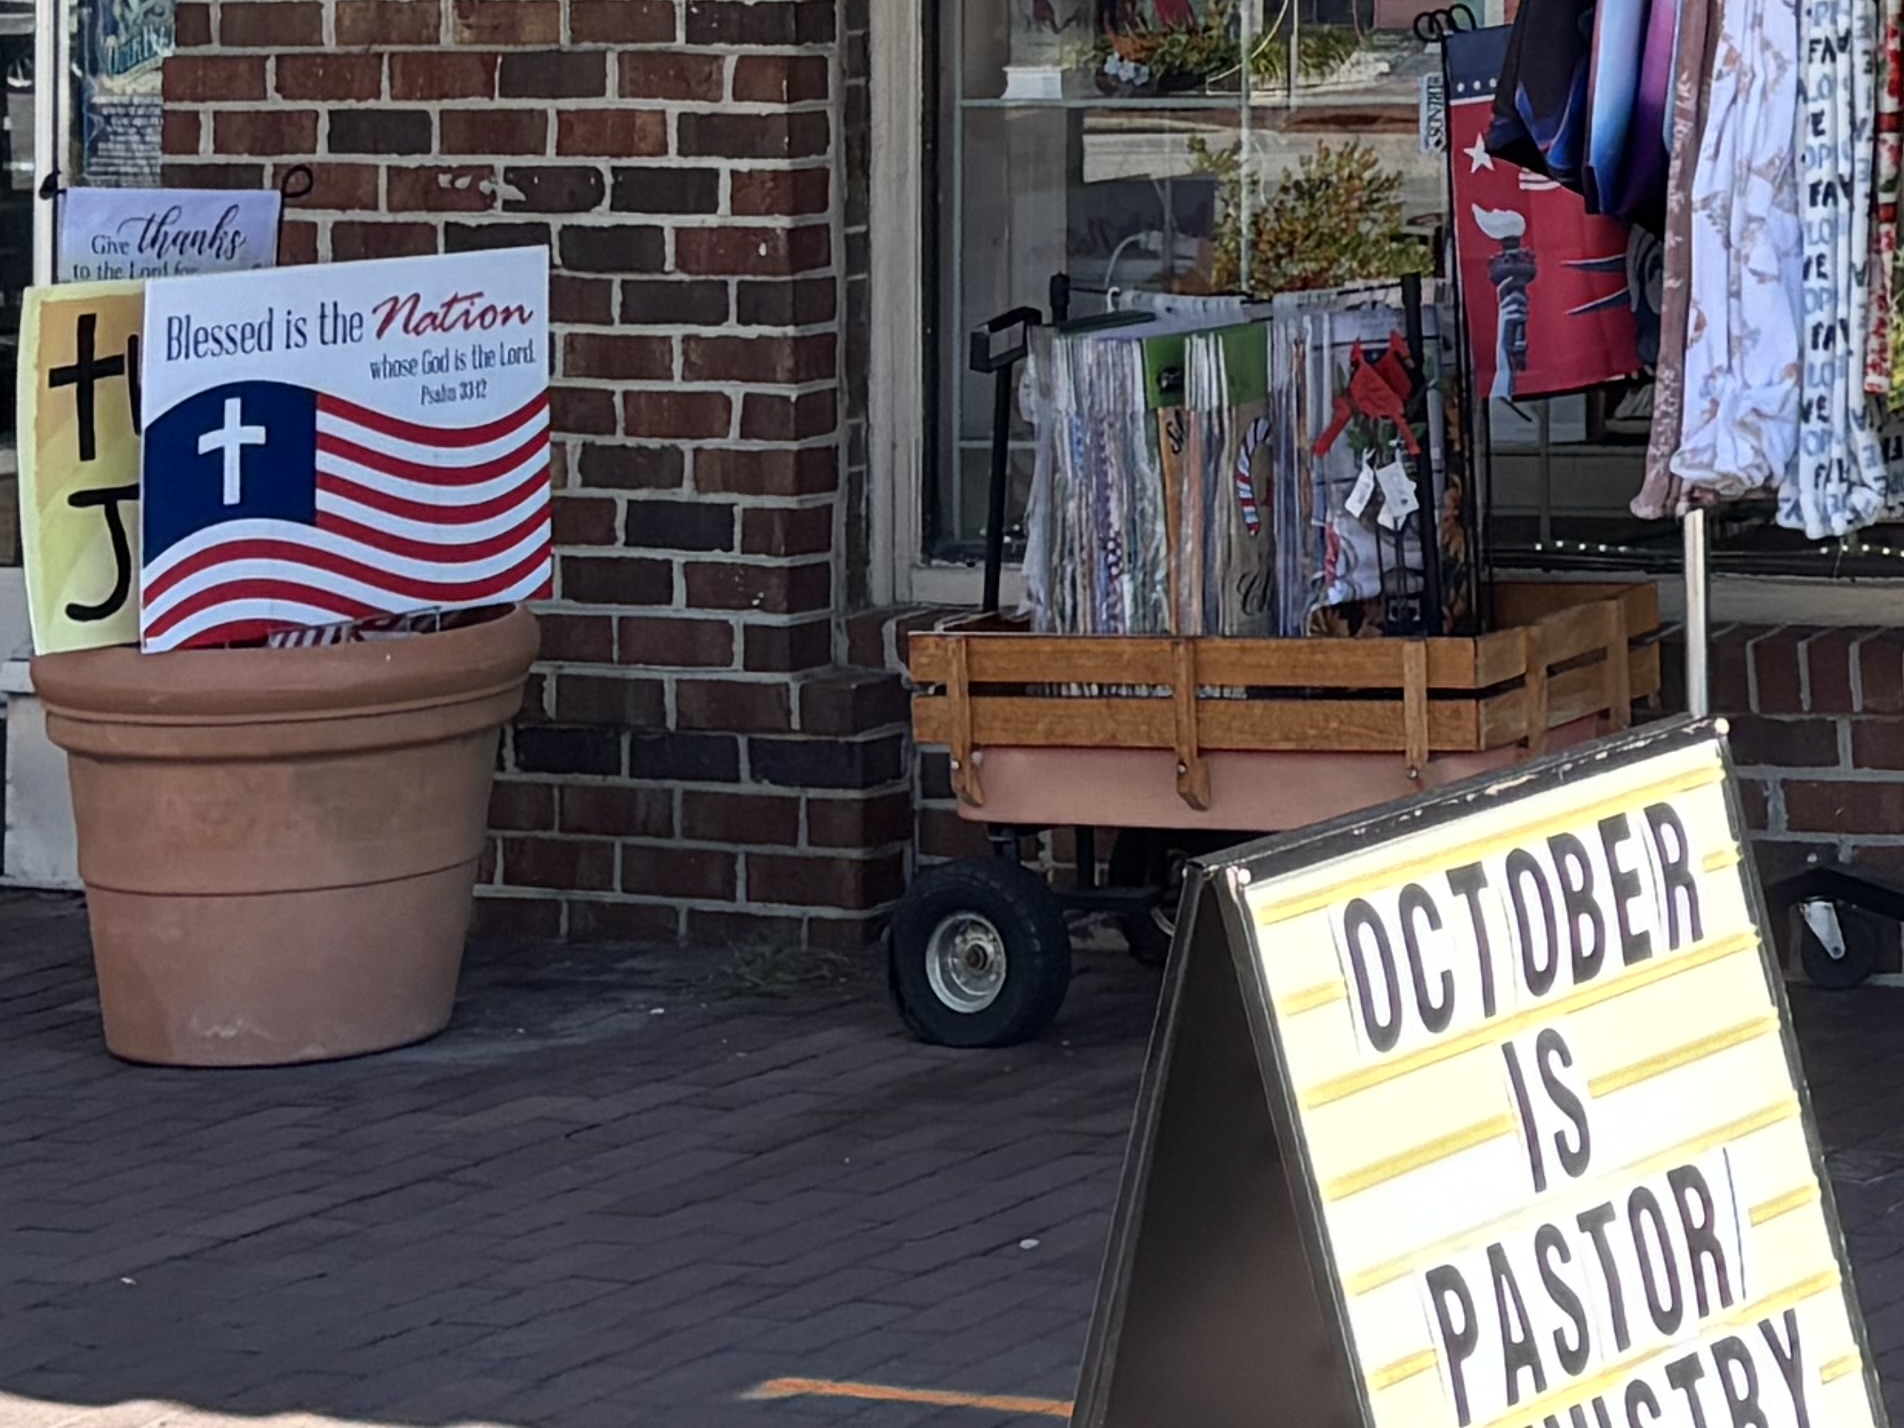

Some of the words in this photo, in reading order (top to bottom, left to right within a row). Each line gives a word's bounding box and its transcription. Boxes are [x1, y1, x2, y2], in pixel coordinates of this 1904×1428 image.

[91, 234, 130, 255] Give
[116, 203, 246, 261] thanks
[73, 263, 91, 281] to
[97, 260, 124, 281] the
[166, 306, 274, 362] Blessed
[285, 308, 308, 347] is
[319, 301, 364, 344] the
[371, 290, 535, 341] Nation
[370, 353, 419, 380] whose
[422, 347, 450, 376] God
[454, 348, 468, 372] is
[471, 343, 496, 371] the
[1343, 801, 1705, 1054] OCTOBER
[1502, 1027, 1593, 1193] IS
[1426, 1162, 1735, 1428] PASTOR
